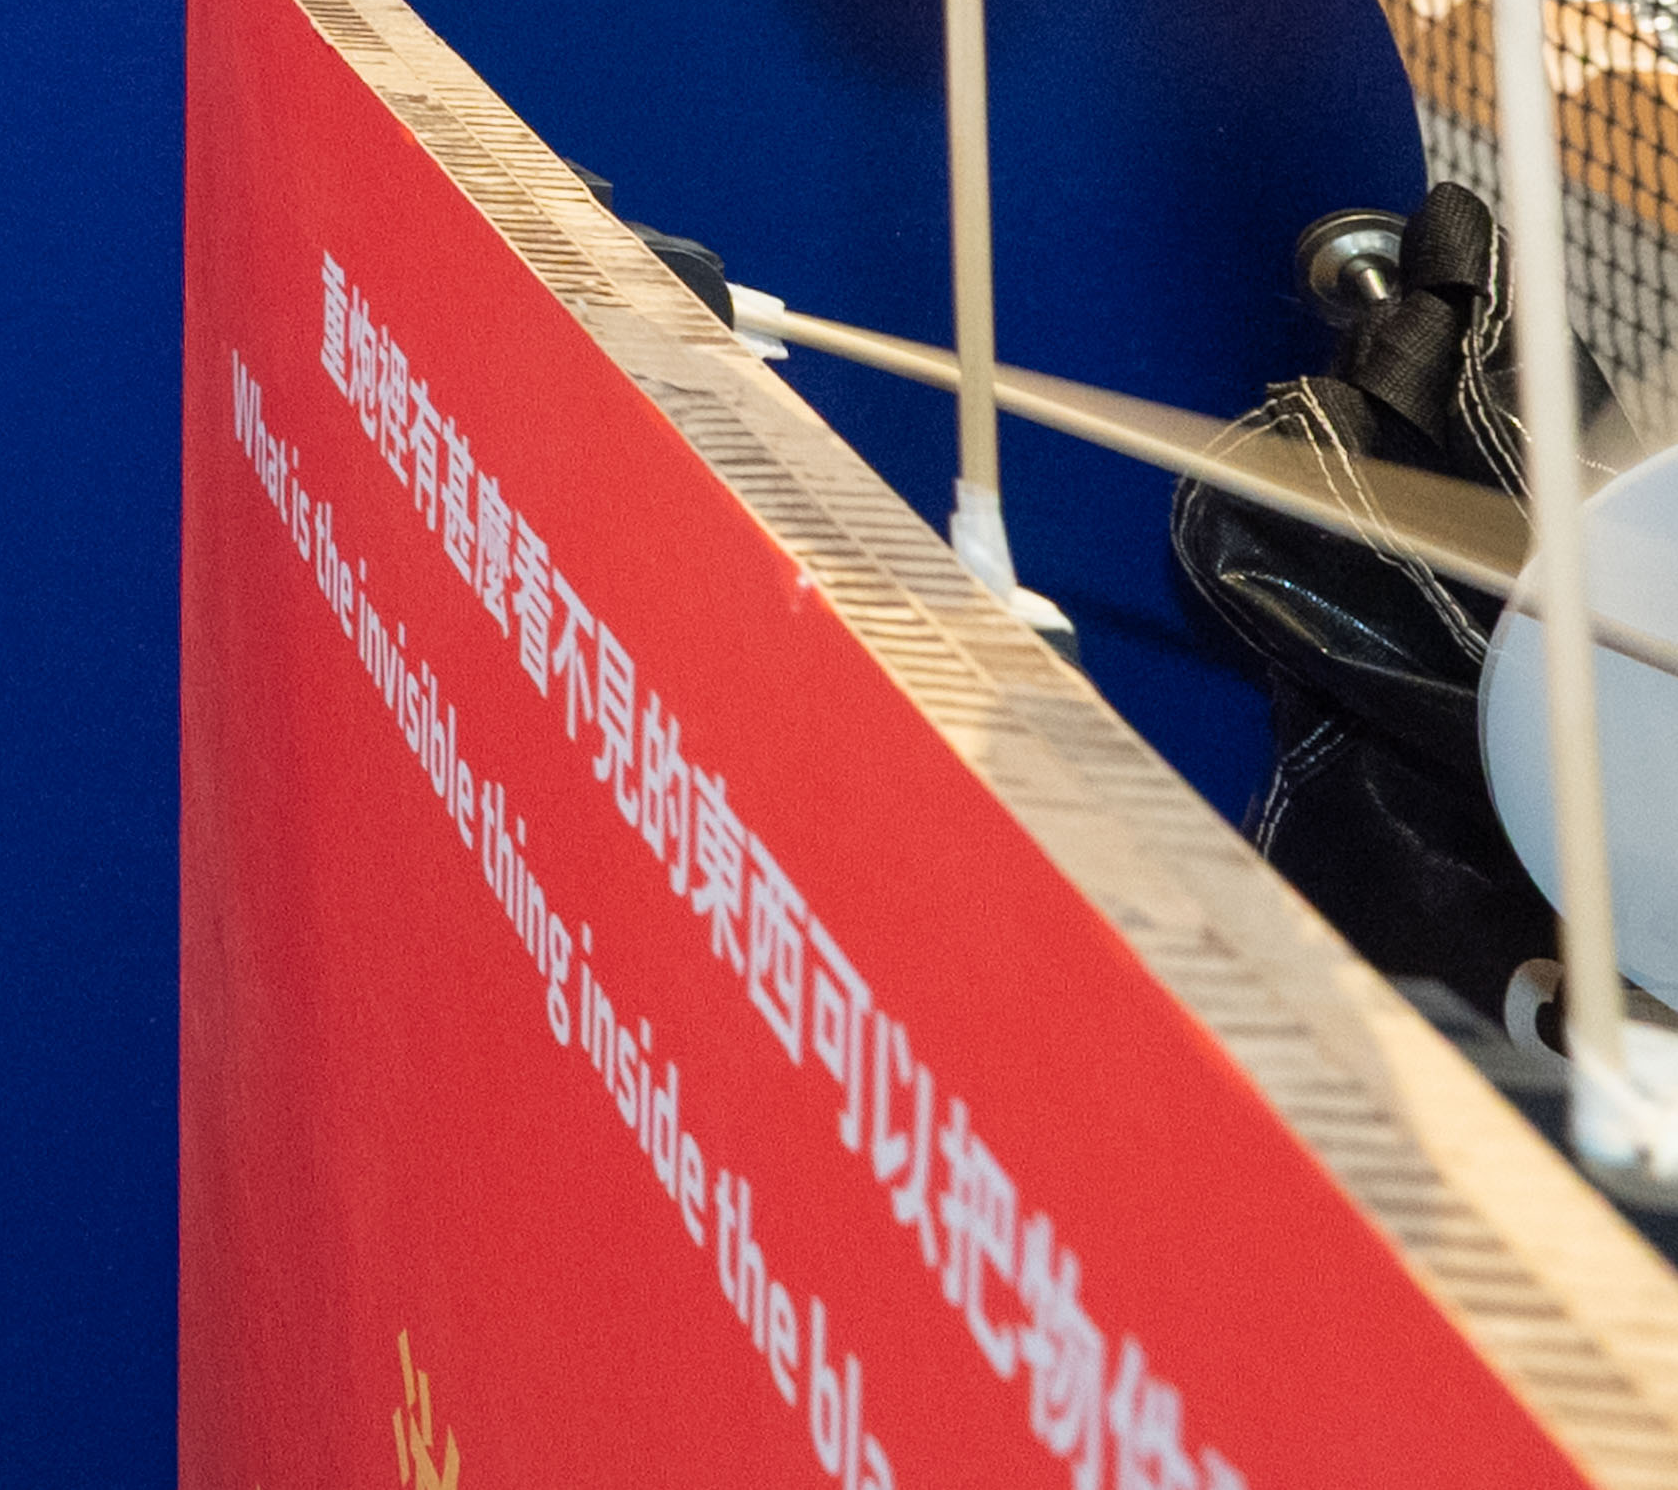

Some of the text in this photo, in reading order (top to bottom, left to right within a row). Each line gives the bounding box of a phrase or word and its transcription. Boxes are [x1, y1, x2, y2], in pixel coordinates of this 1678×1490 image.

[231, 347, 289, 525] What
[291, 446, 311, 562] is
[314, 500, 354, 641] the
[358, 557, 475, 851] invisible
[480, 779, 573, 1047] thing
[580, 921, 709, 1248] inside
[715, 1167, 799, 1407] the
